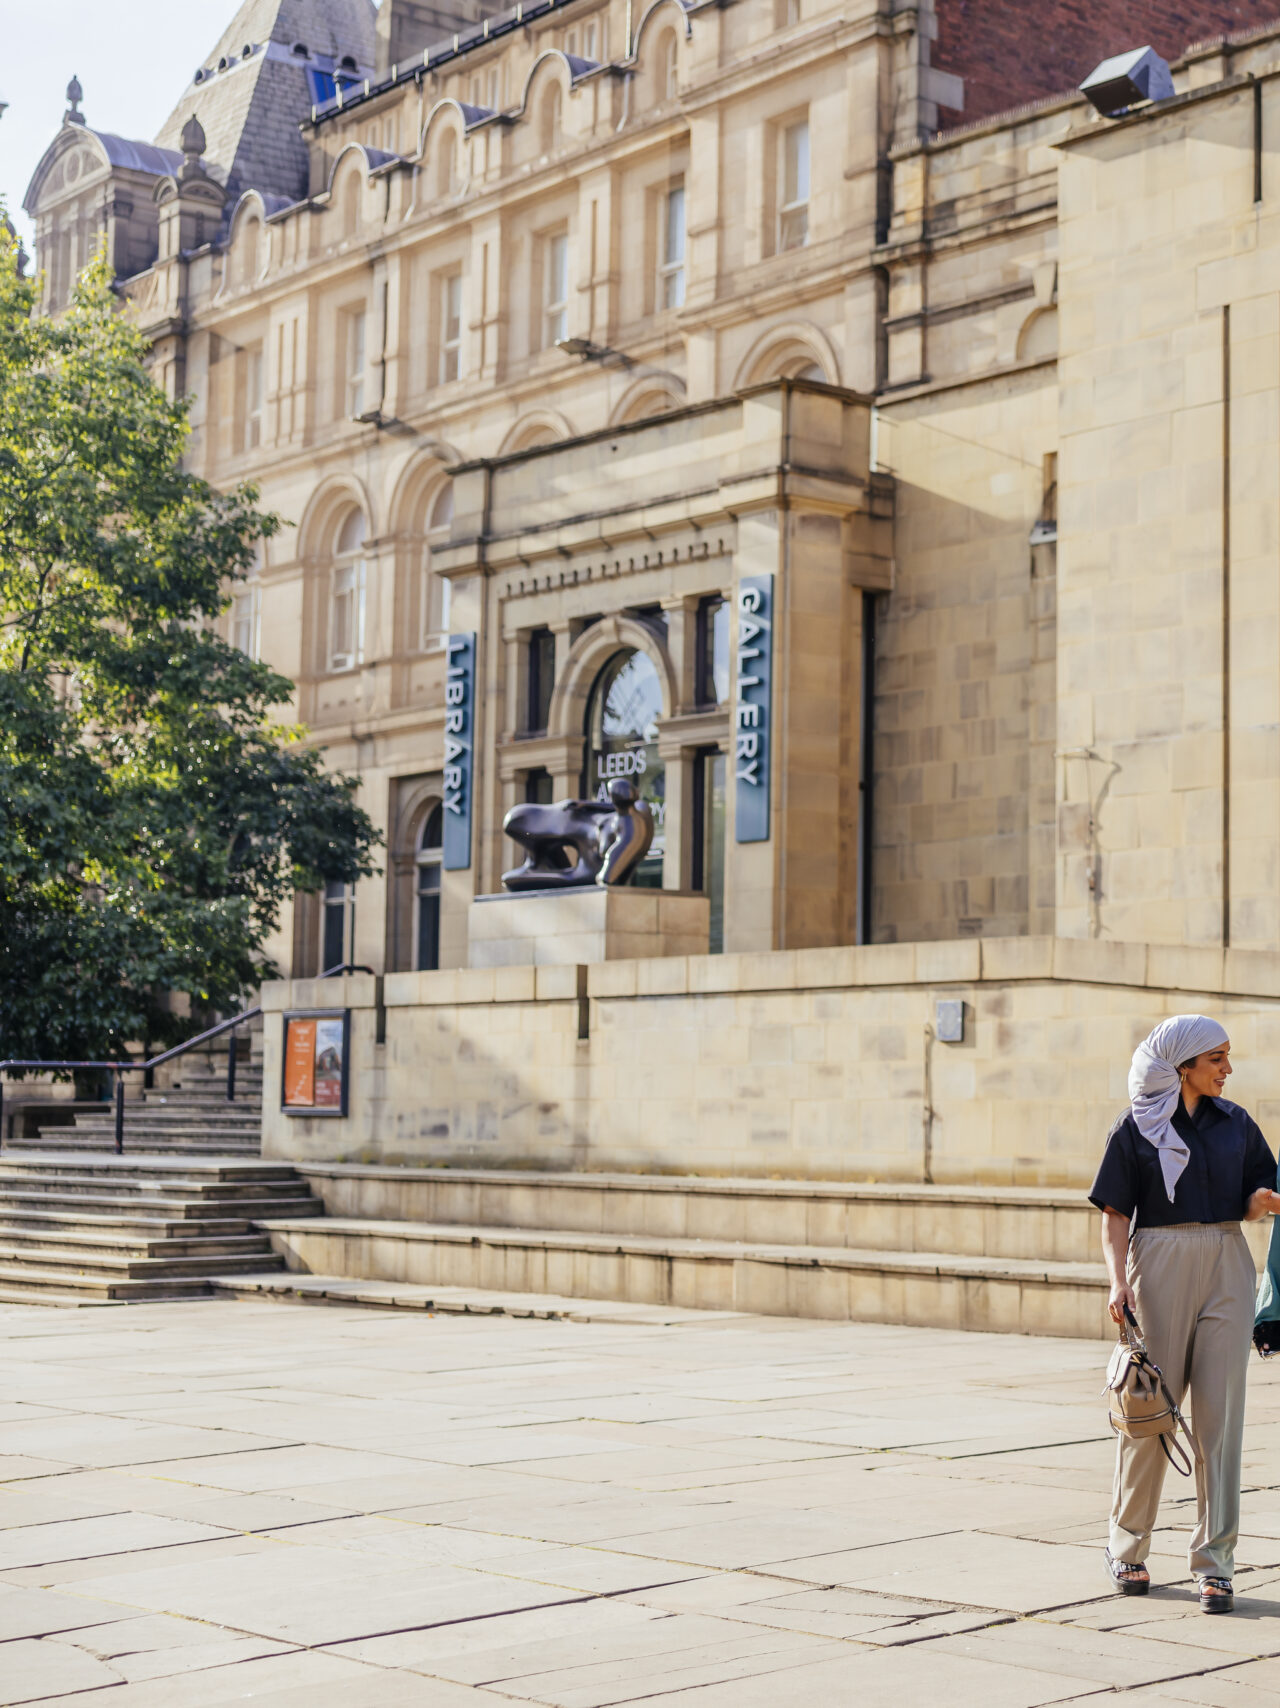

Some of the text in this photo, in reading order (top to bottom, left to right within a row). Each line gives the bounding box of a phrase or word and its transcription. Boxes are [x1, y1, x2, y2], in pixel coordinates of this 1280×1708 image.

[442, 643, 465, 815] LIBRARY
[597, 749, 647, 778] LEEDS
[736, 586, 761, 786] GALLERY
